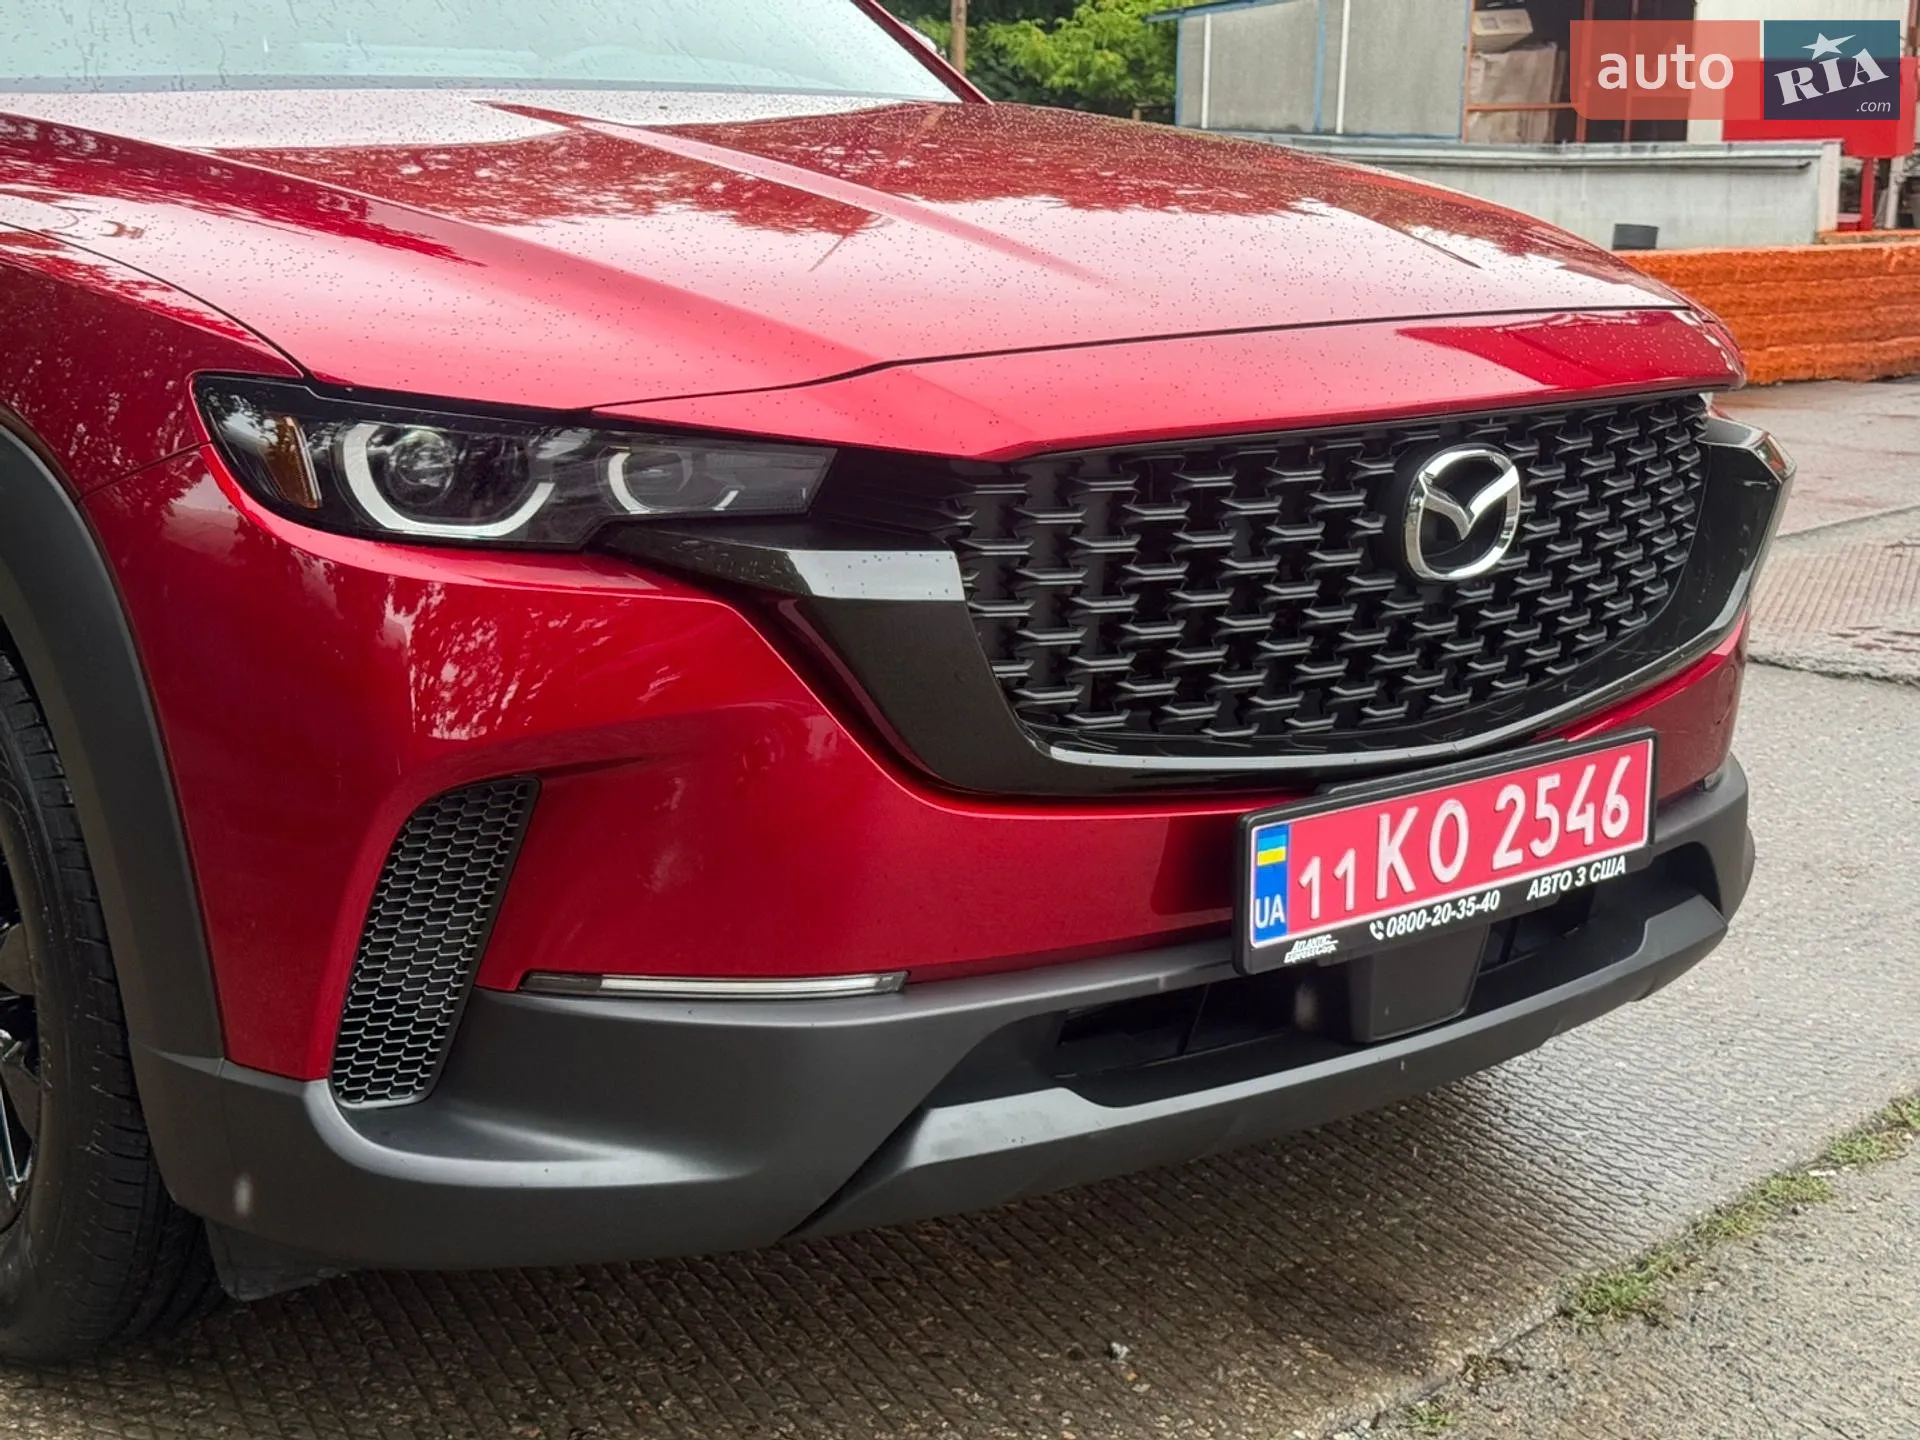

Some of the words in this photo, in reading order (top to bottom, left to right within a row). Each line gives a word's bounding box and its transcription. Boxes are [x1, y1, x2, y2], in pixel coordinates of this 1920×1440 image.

[1492, 755, 1632, 871] 2546
[1526, 870, 1573, 901] АВТО
[1589, 854, 1628, 883] США
[1255, 893, 1287, 929] UA
[1385, 889, 1501, 938] 0800-20-35-40
